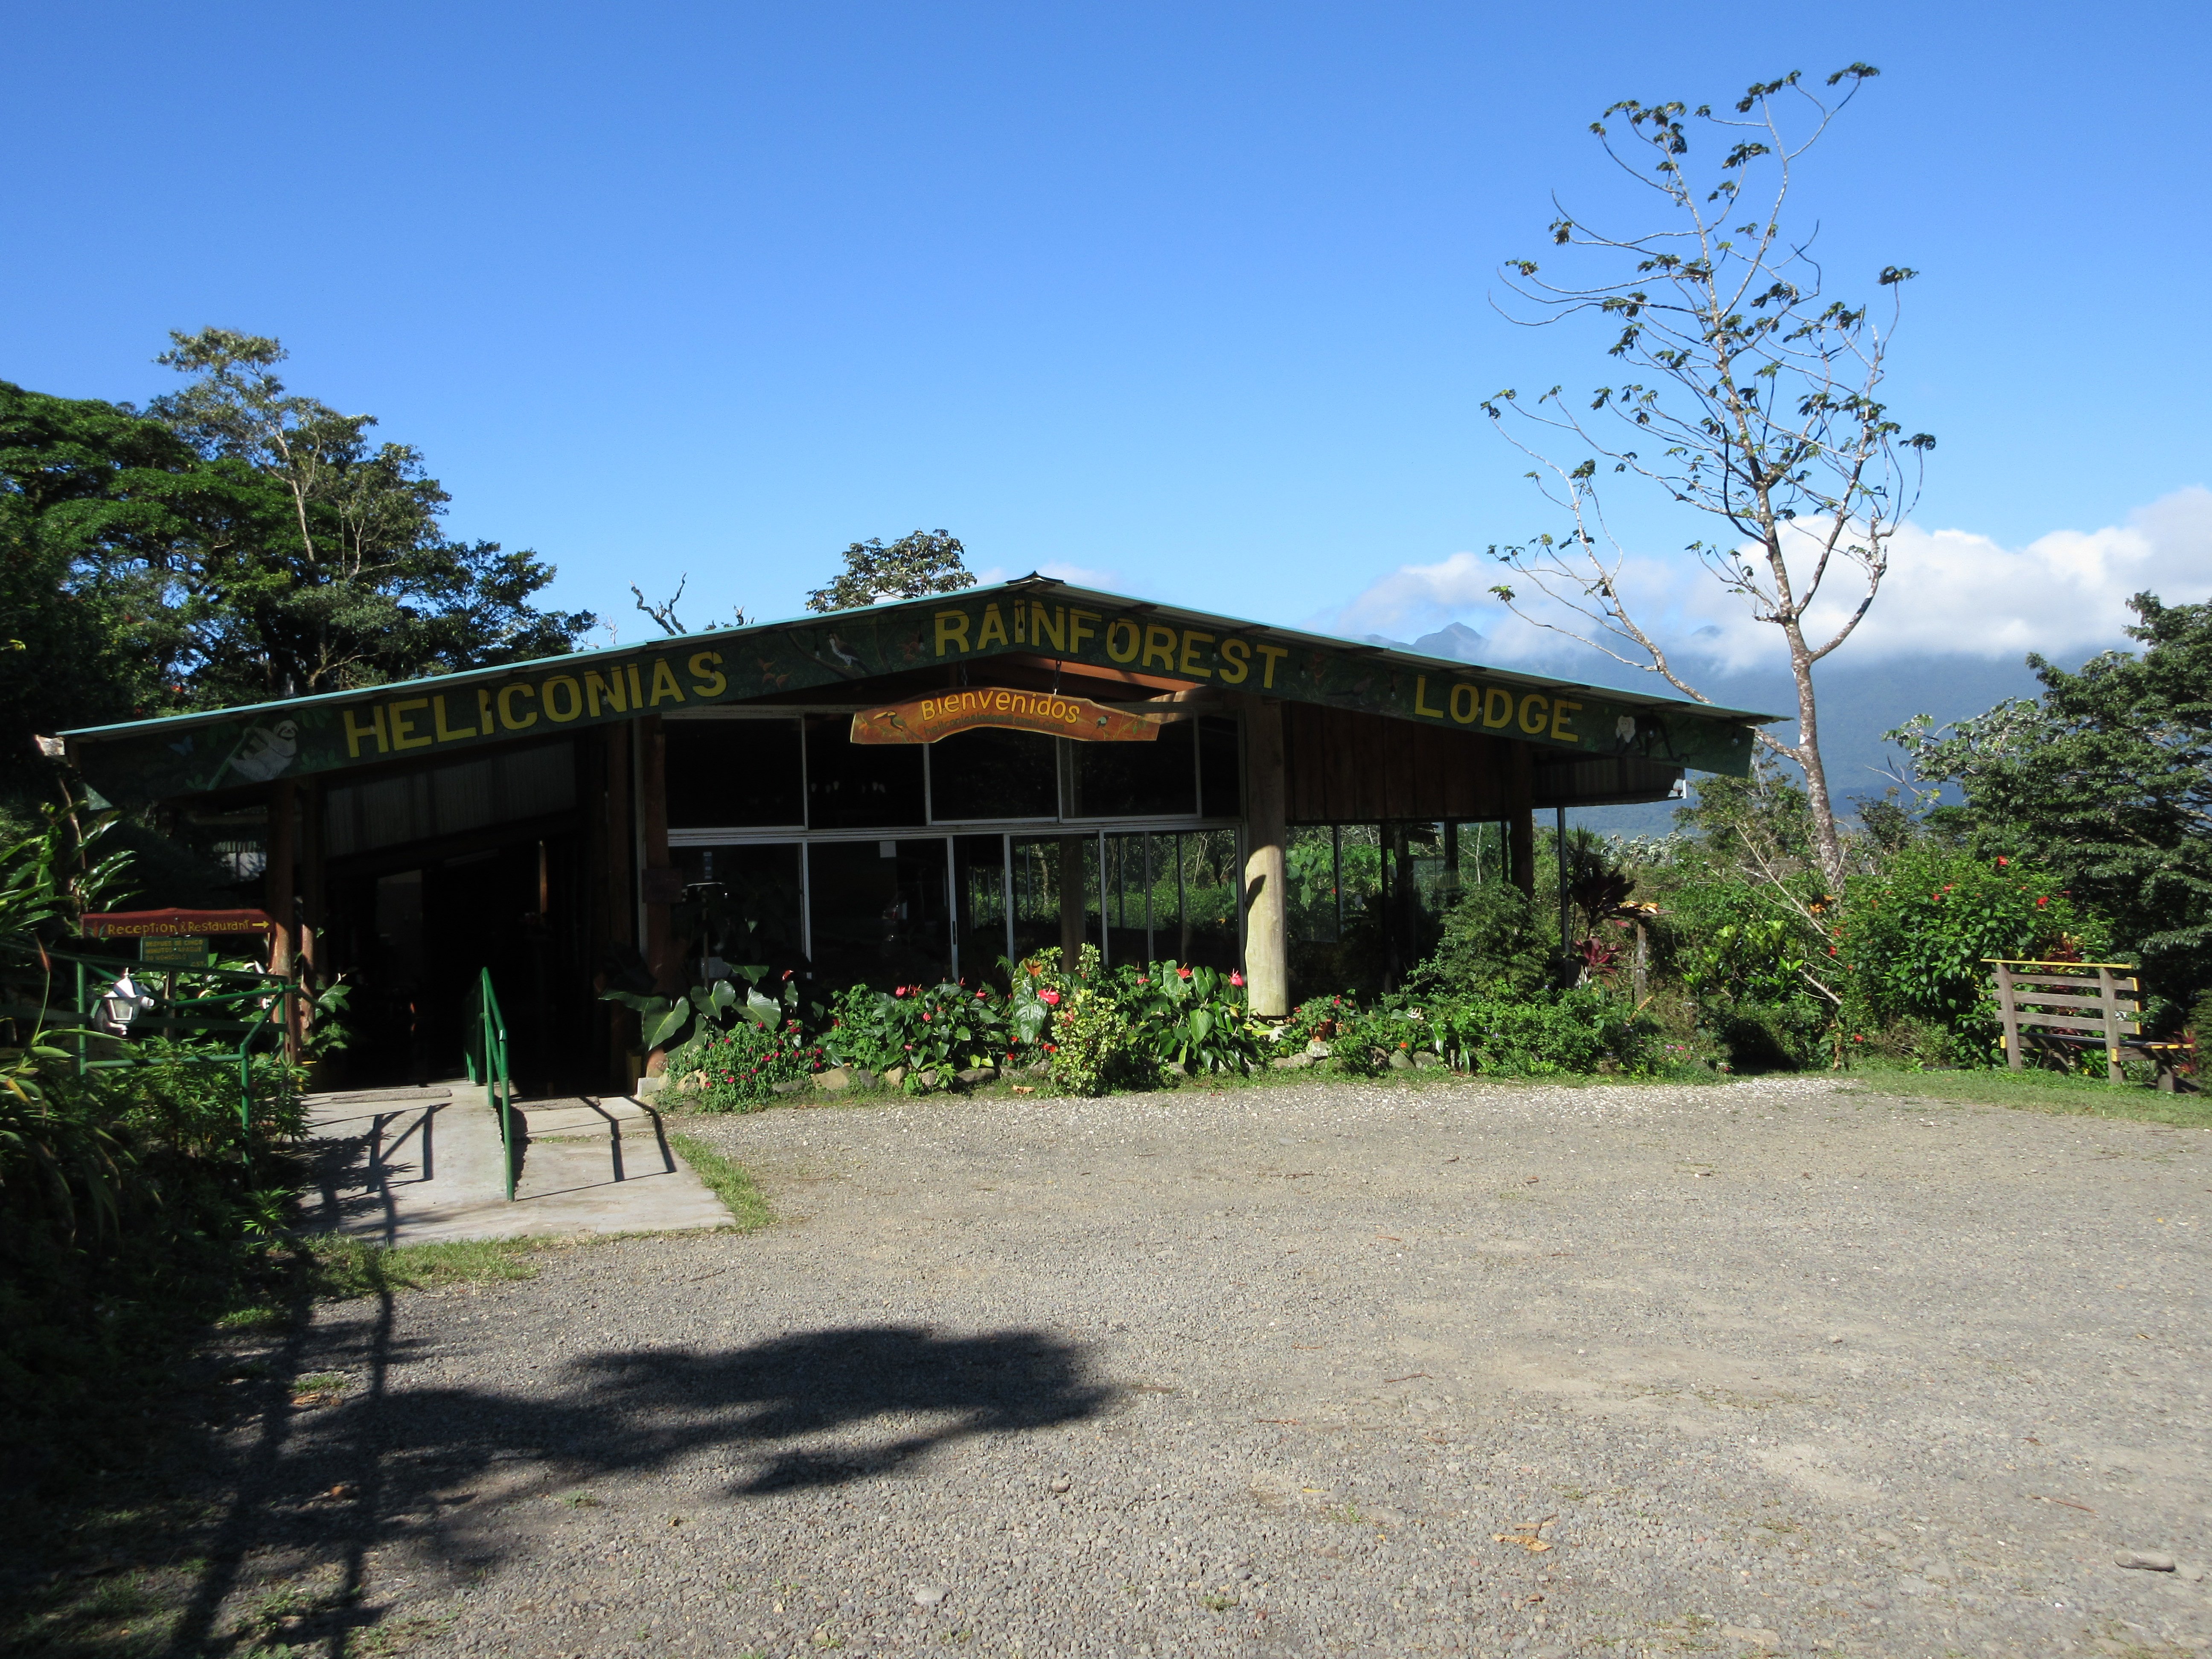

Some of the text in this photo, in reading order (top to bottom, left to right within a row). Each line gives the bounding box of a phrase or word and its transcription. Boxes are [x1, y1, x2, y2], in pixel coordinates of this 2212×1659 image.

[343, 599, 1583, 758] HELICONIAS RAINFOREST LODGE
[107, 919, 250, 937] Reception & Restaurant
